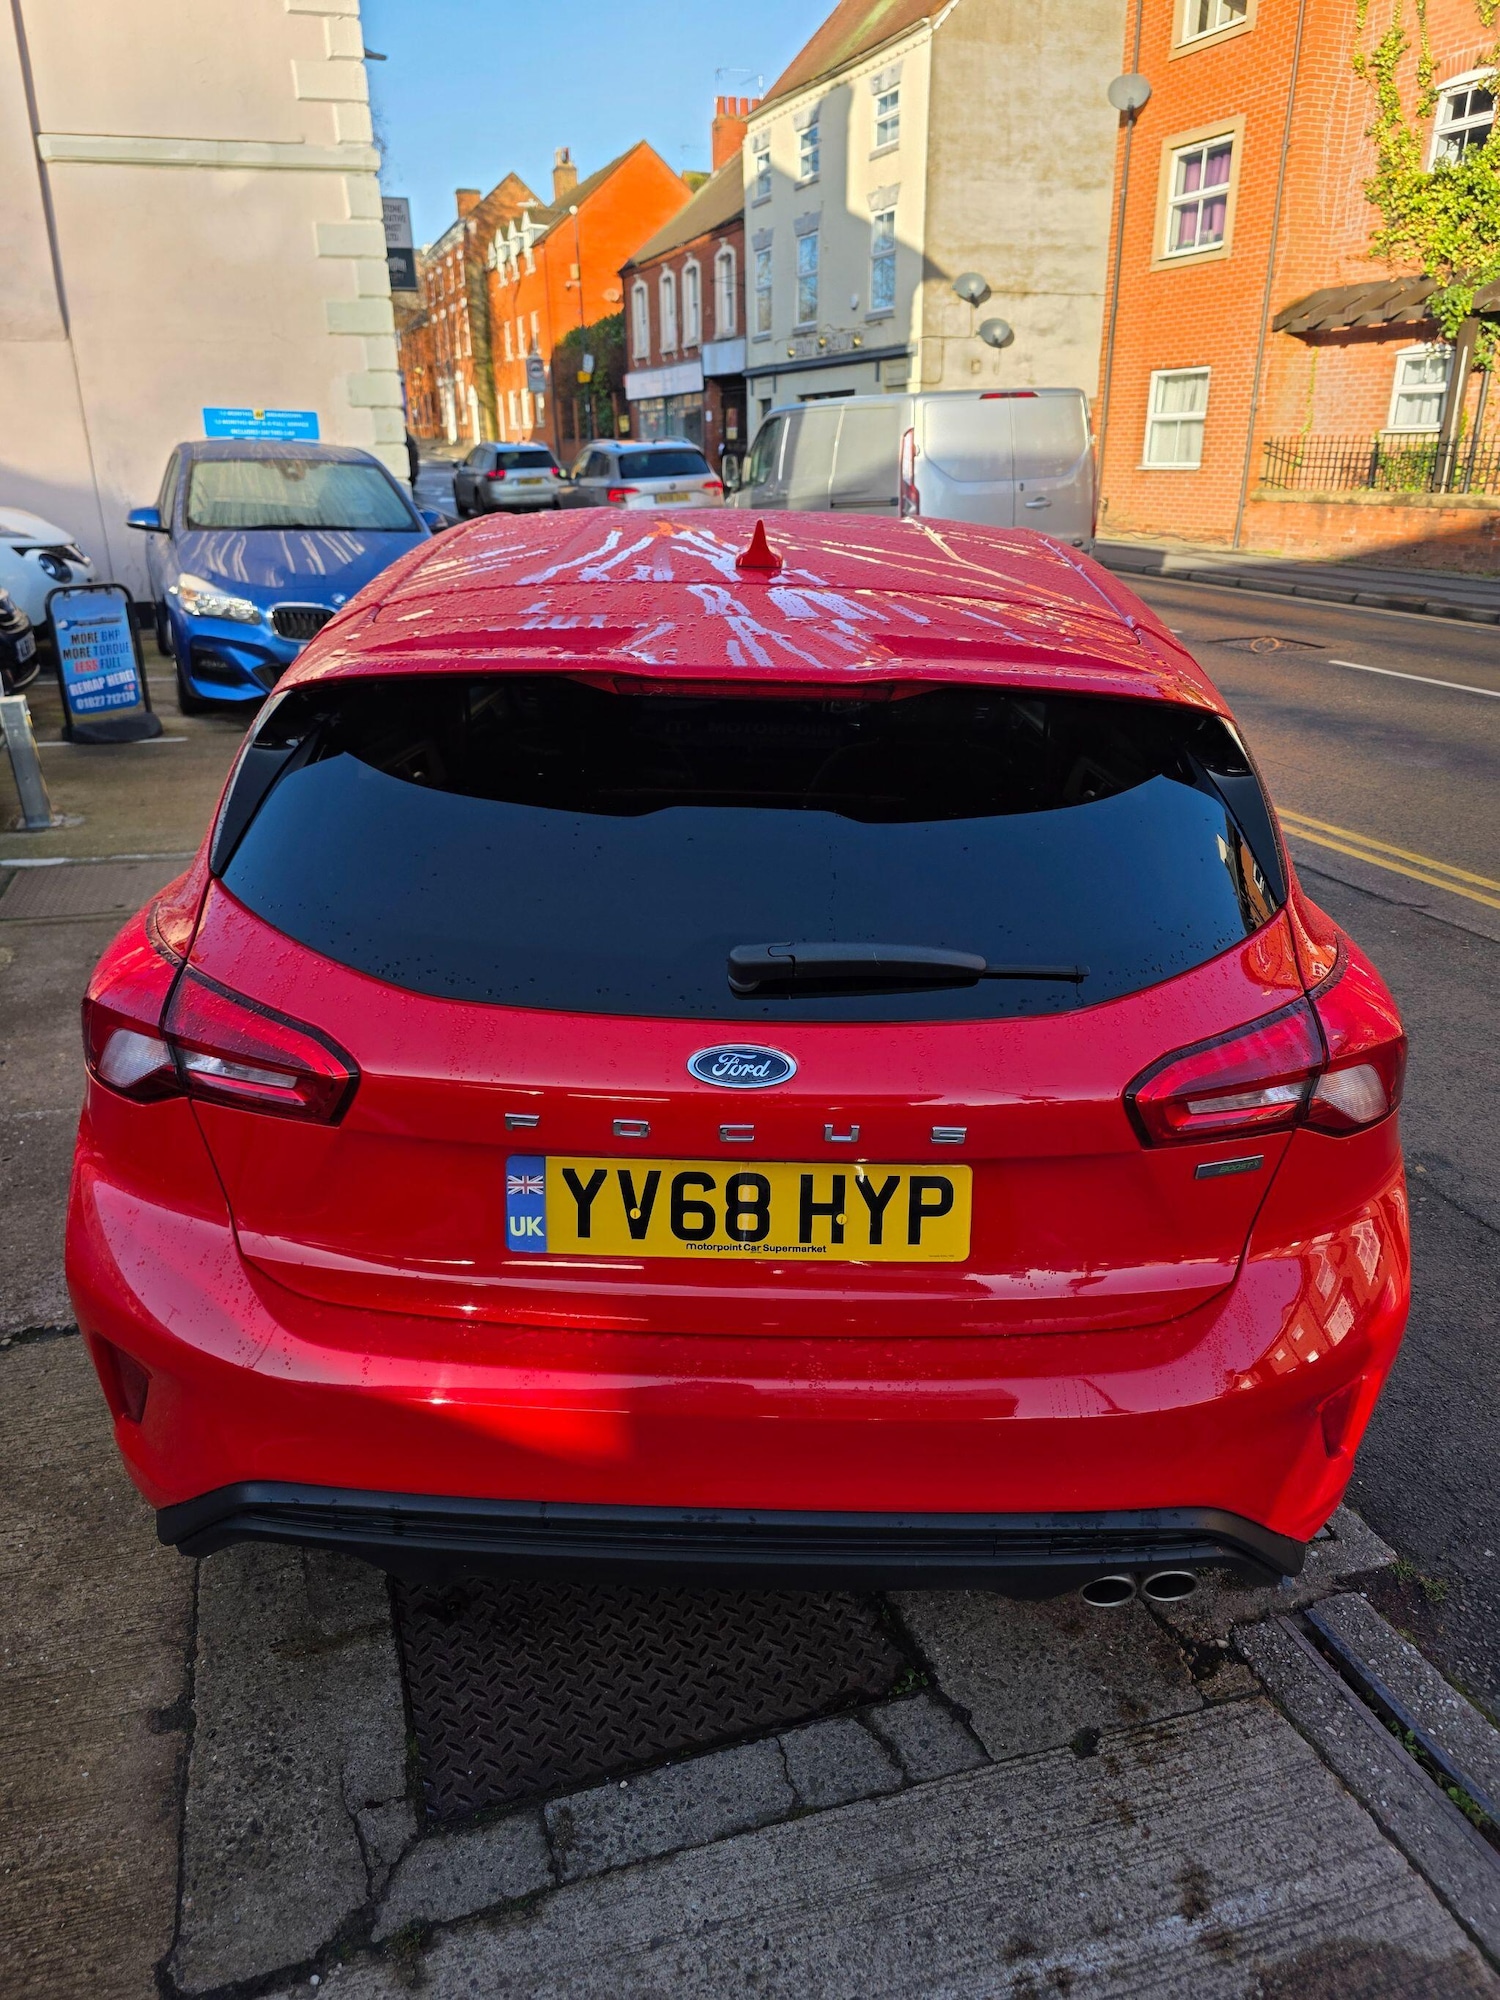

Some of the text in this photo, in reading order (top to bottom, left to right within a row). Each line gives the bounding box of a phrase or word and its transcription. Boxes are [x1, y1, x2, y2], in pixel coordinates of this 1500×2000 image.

[71, 631, 98, 645] MORE
[63, 642, 129, 660] MORE TORQUE
[74, 659, 98, 674] LESS
[69, 677, 105, 696] REMAP
[712, 1053, 771, 1077] Ford
[505, 1113, 967, 1144] FOCUS
[562, 1168, 954, 1244] YV68 HYP
[510, 1216, 545, 1237] UK
[743, 1243, 761, 1252] Car
[763, 1244, 827, 1254] Supermarket
